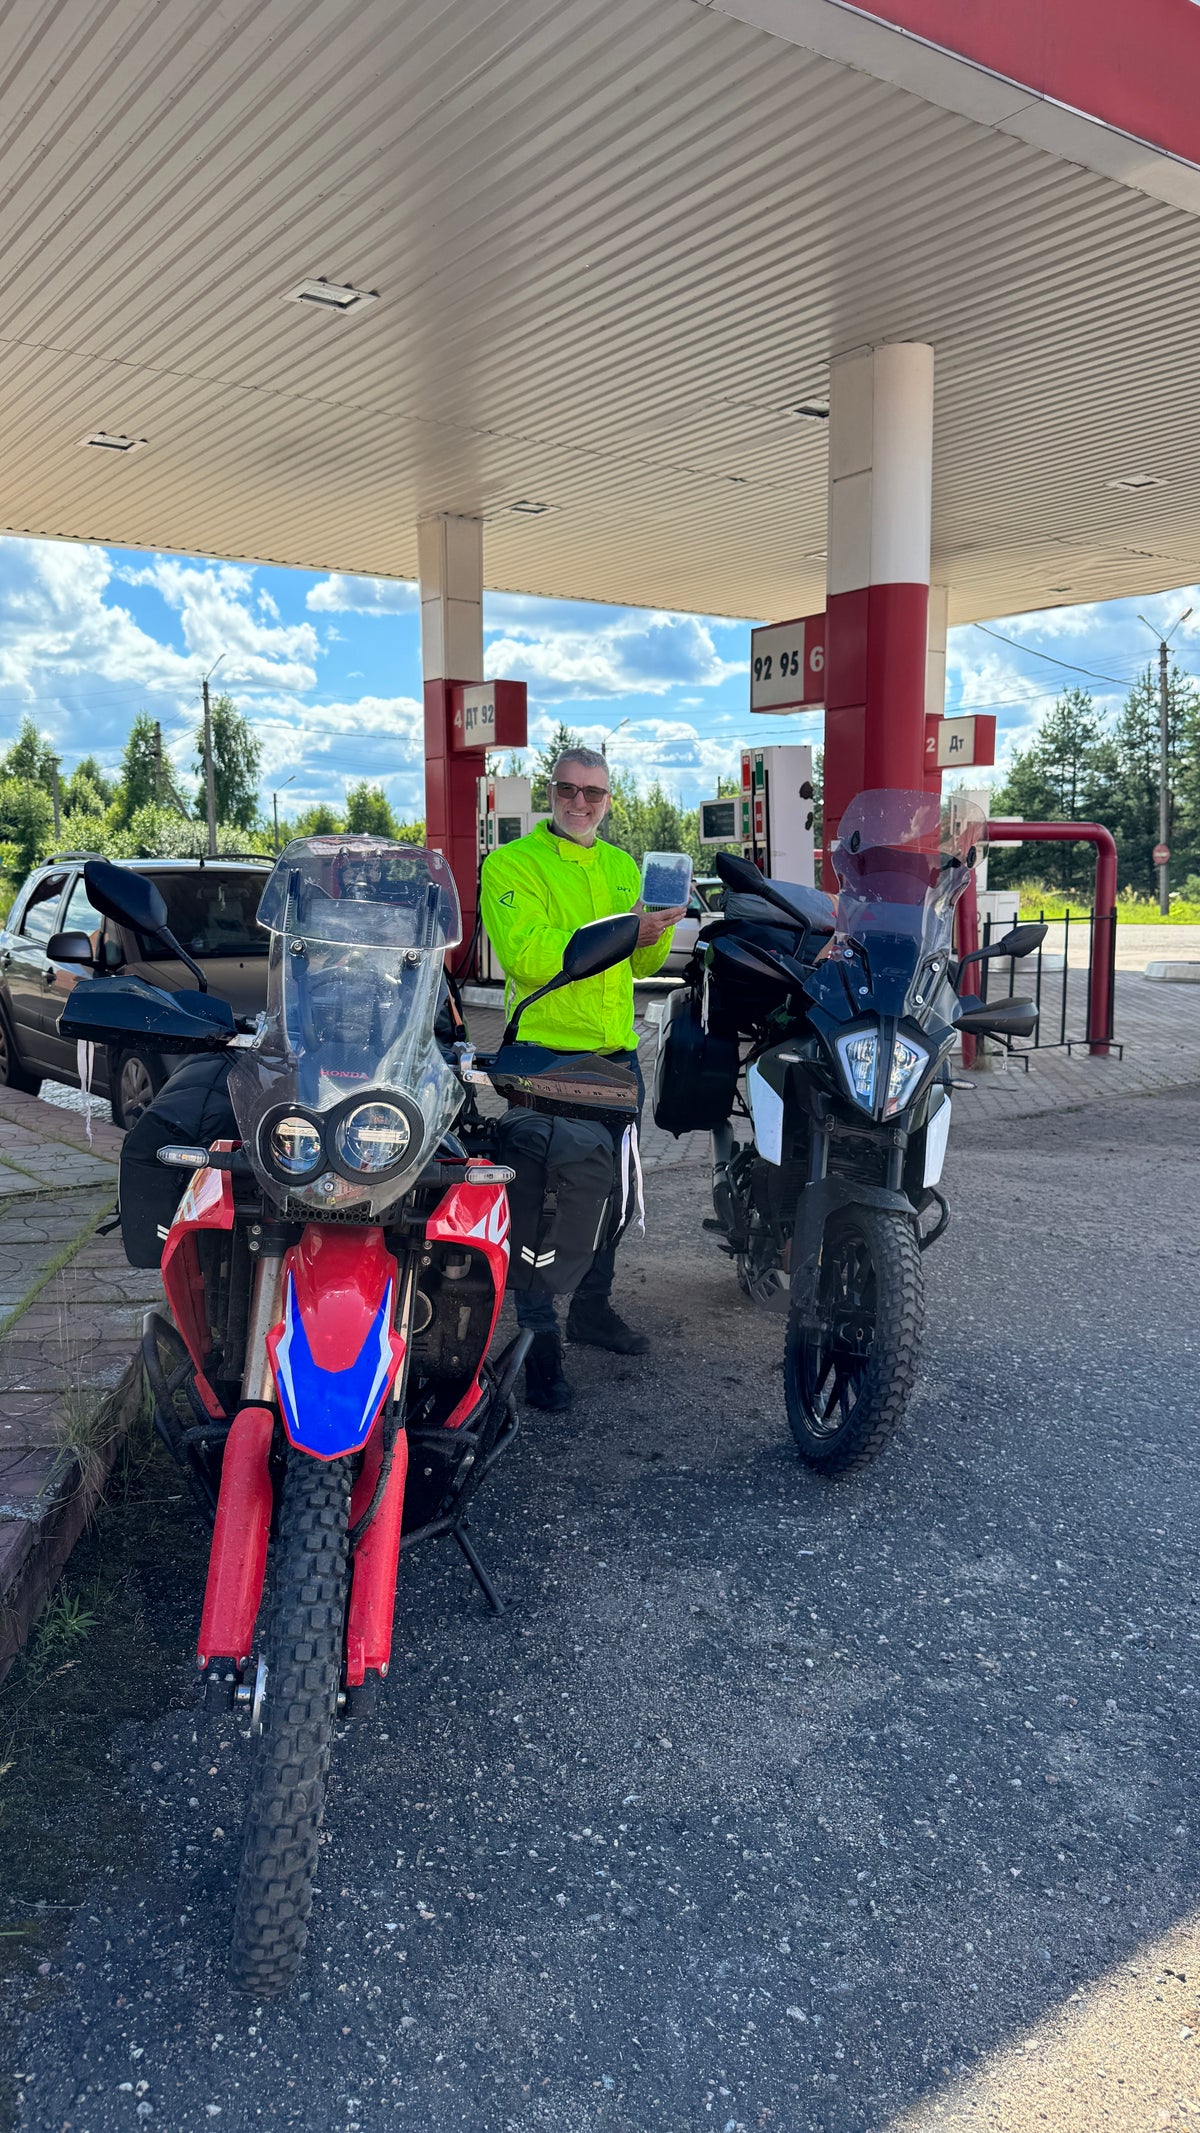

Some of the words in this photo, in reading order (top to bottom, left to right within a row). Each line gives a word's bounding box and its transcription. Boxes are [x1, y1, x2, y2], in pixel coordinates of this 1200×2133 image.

[754, 656, 772, 682] 92
[780, 650, 799, 678] 95
[809, 646, 825, 673] 6
[453, 709, 463, 729] 4
[465, 706, 479, 730] ДТ
[481, 704, 495, 724] 92
[926, 737, 936, 753] 2
[949, 735, 965, 753] Дт
[319, 1069, 369, 1080] HONDA
